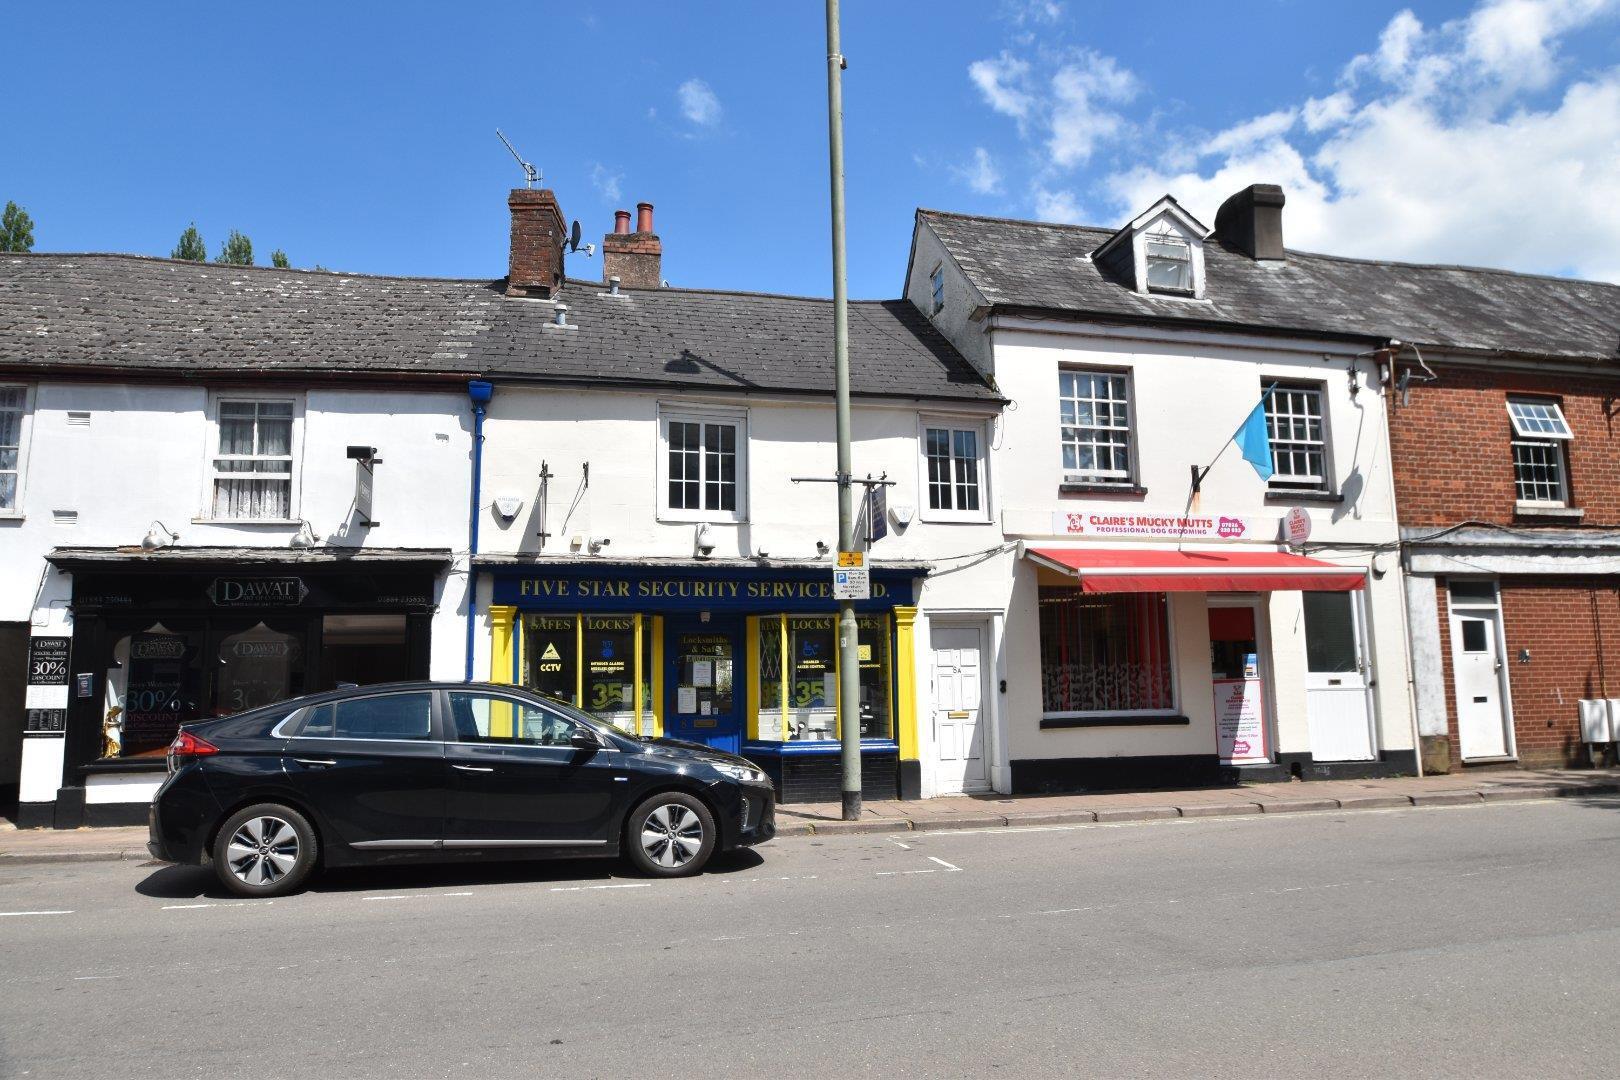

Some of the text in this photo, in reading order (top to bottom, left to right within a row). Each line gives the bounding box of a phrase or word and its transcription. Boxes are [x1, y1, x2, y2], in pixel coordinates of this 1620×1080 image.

[1090, 515, 1212, 528] CLAIRE'S MUCKY MUTTS
[223, 581, 295, 601] DAWAT
[519, 580, 570, 597] FIVE
[577, 580, 631, 598] STAR
[638, 581, 740, 599] SECURITY
[530, 618, 571, 631] SAFES
[588, 618, 631, 631] LOCKS
[793, 618, 832, 631] LOCKS
[683, 635, 727, 644] Locksmiths
[242, 643, 281, 655] DAWAT
[690, 646, 699, 654] &
[32, 661, 66, 675] 30%
[540, 664, 562, 672] CCTV
[591, 683, 623, 707] 35
[796, 681, 825, 704] 35
